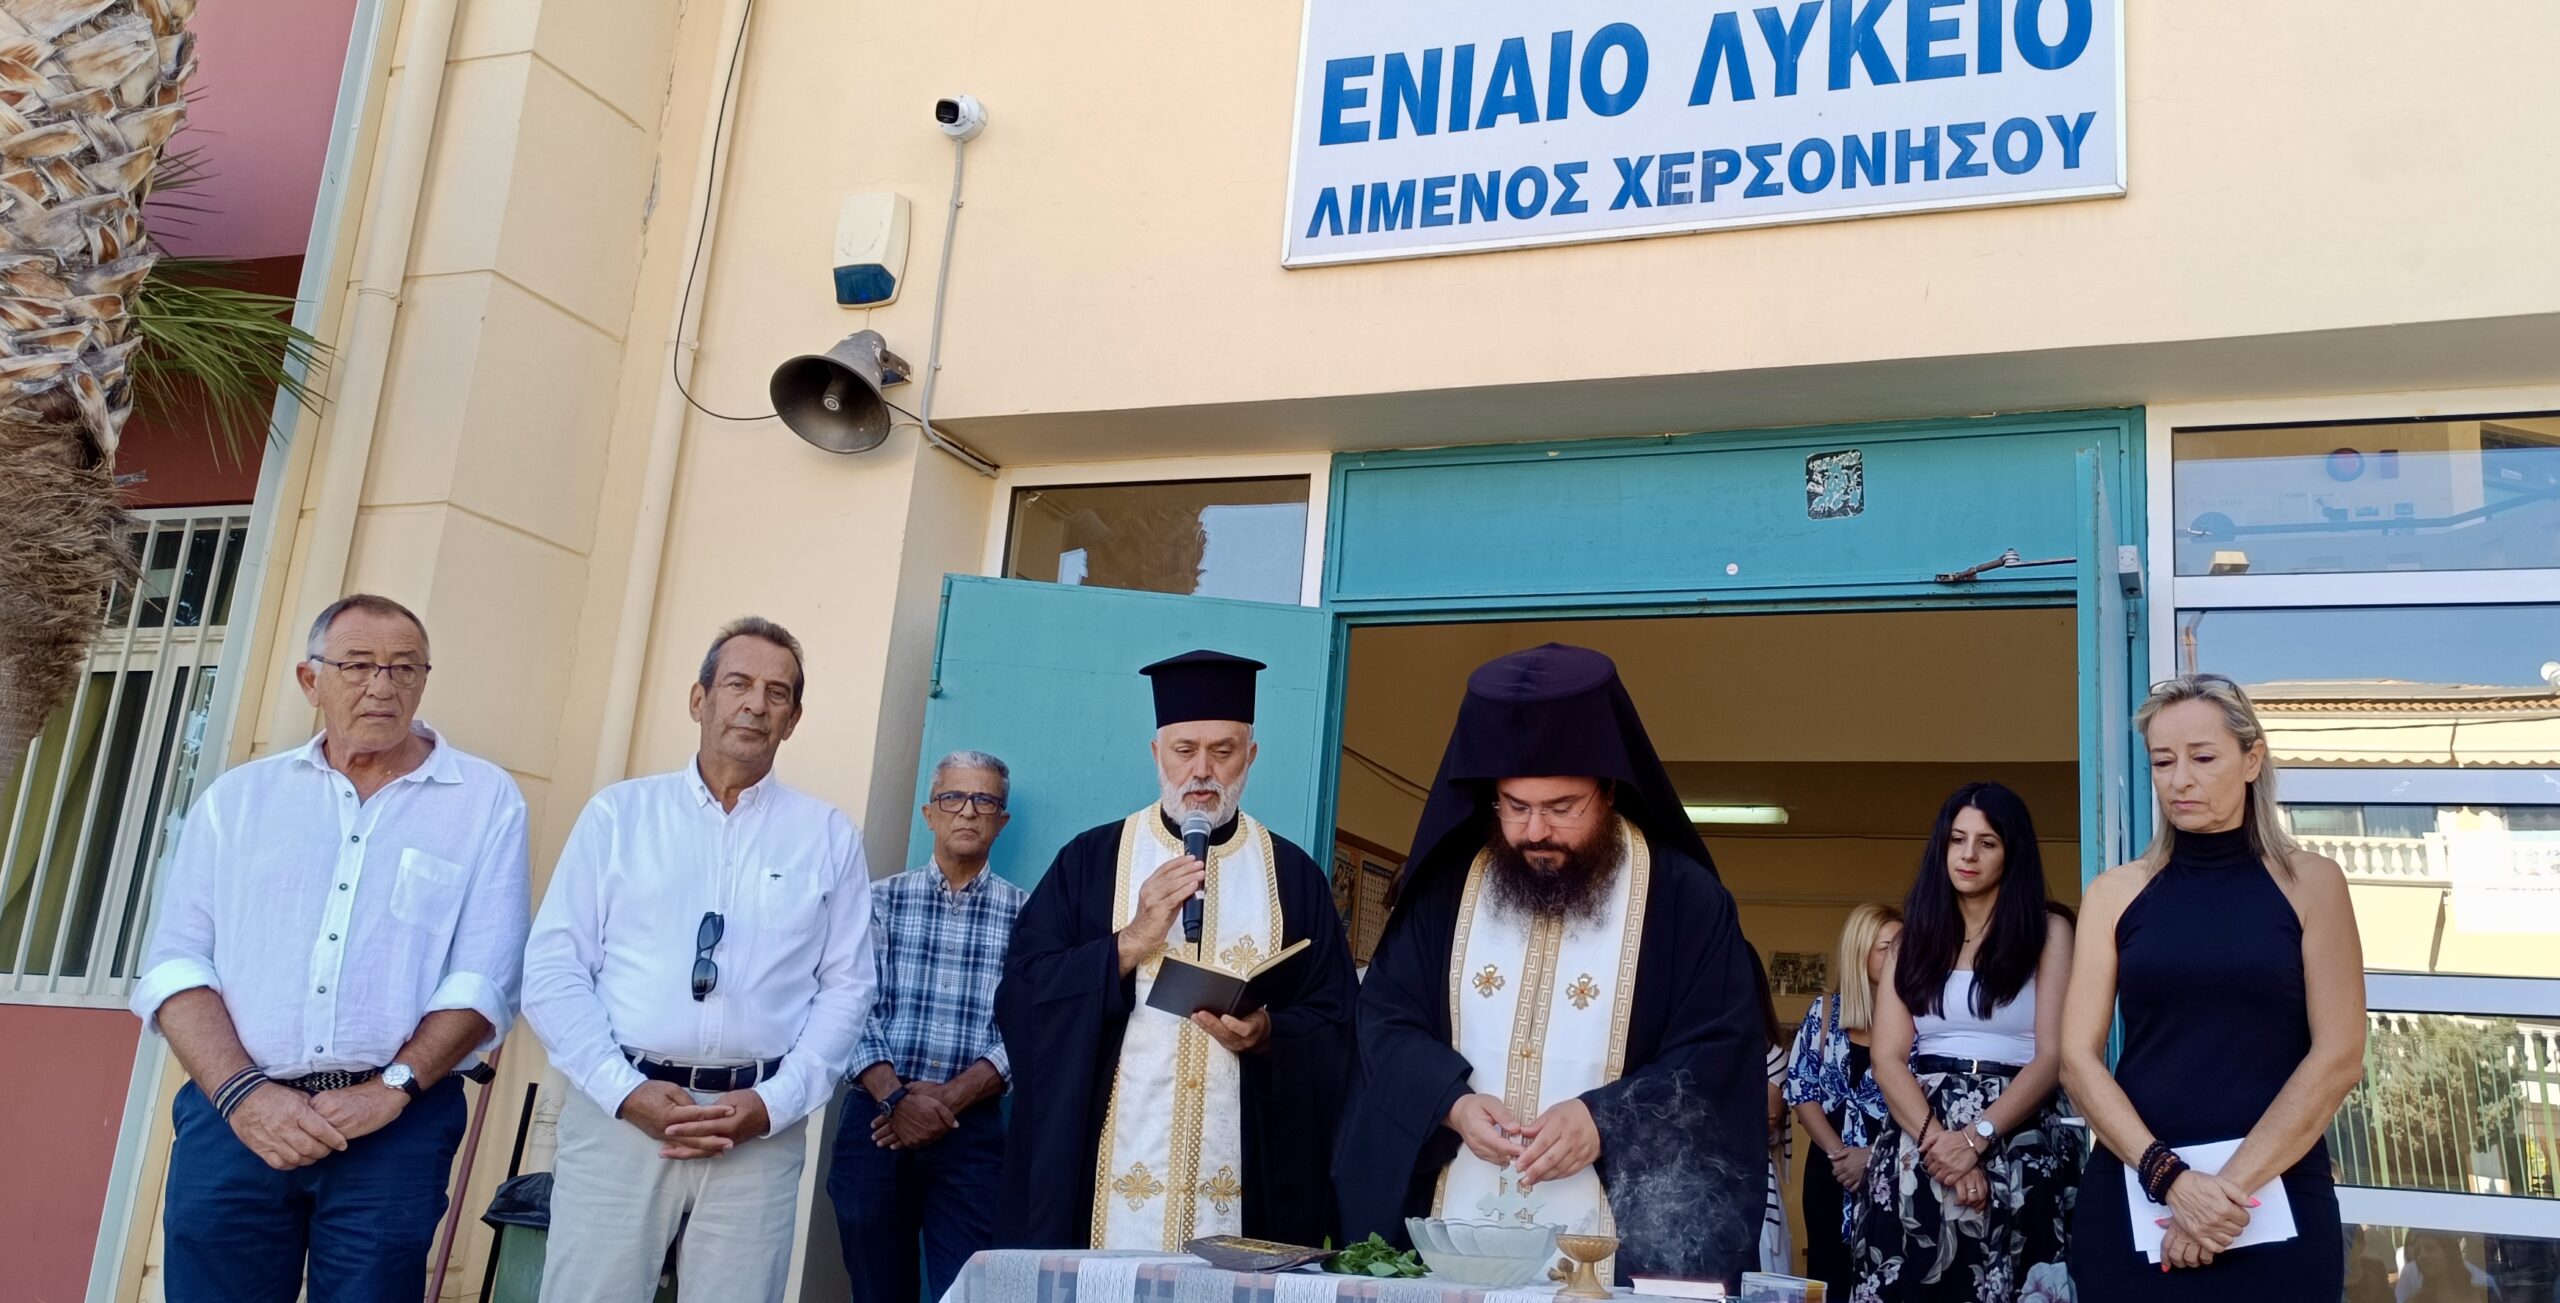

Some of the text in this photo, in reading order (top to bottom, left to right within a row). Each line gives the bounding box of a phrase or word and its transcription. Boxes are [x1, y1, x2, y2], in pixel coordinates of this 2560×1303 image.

[1319, 0, 2093, 146] ΕΝΙΑΙΟ ΛΥΚΕΙΟ
[1306, 111, 2097, 239] ΛΙΜΕΝΟΣ ΧΕΡΣΟΝΗΣΟΥ
